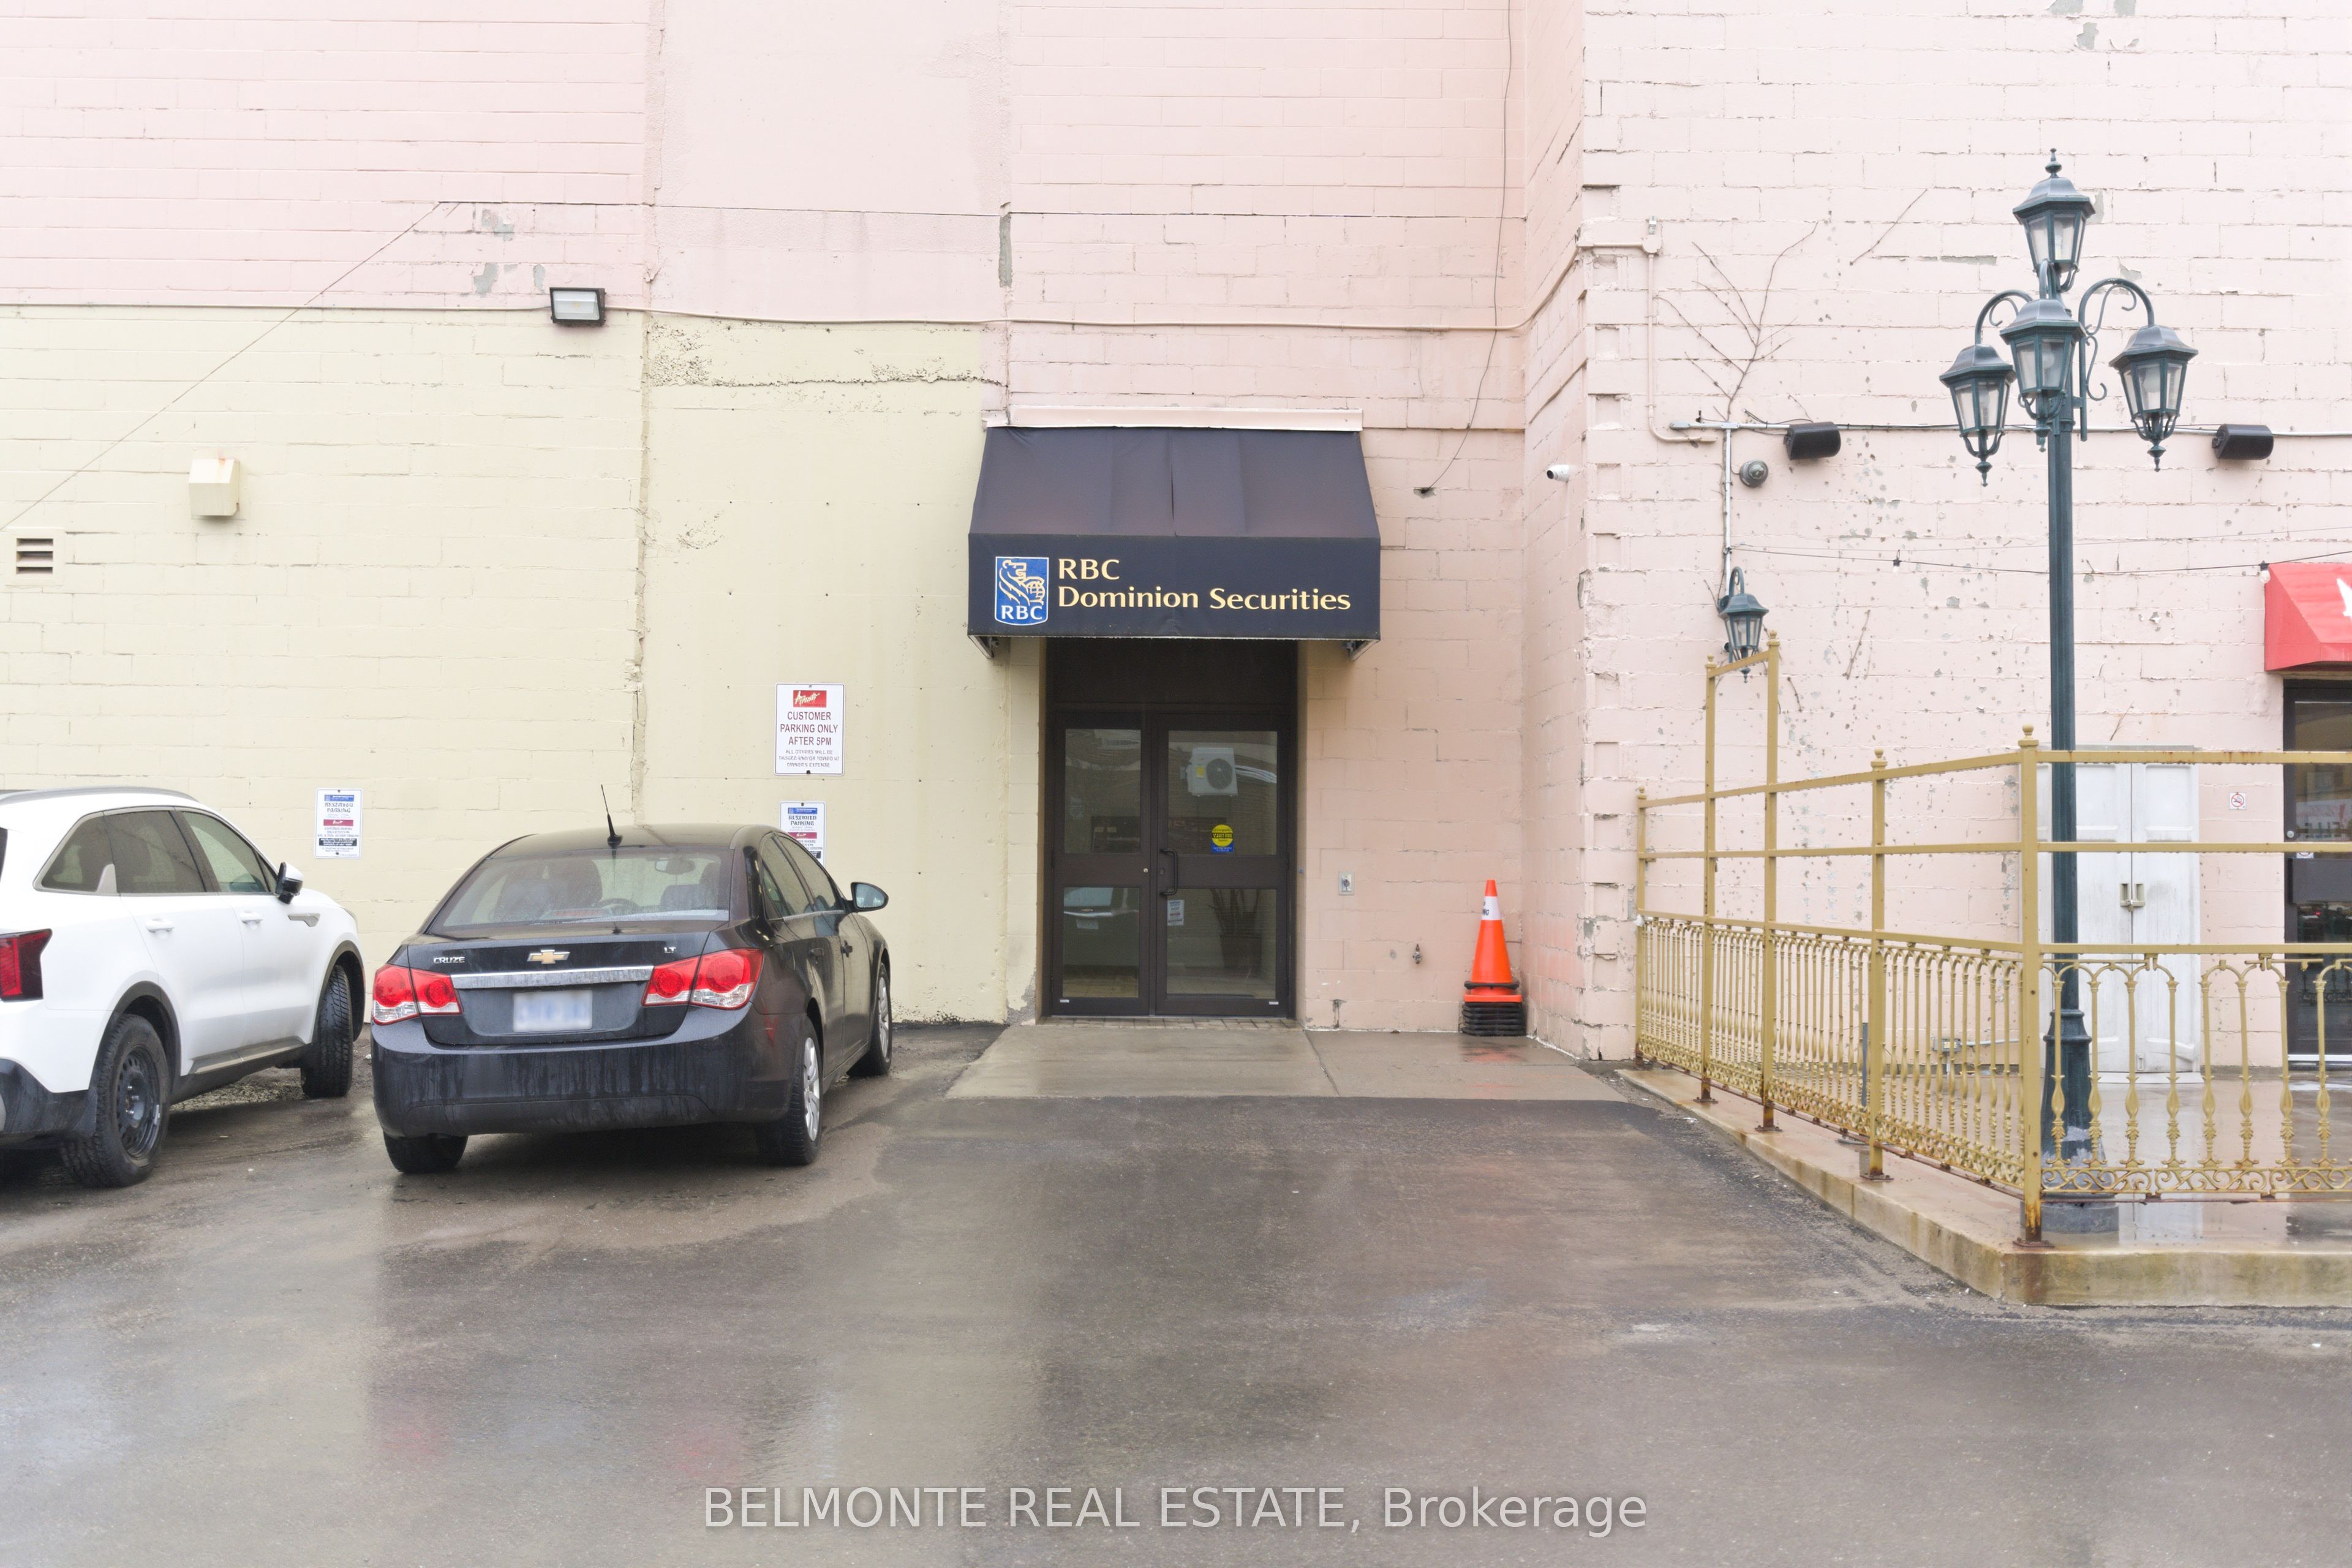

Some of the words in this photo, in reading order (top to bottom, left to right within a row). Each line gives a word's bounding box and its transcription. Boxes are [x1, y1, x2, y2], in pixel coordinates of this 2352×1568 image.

[1058, 558, 1120, 580] RBC
[1058, 586, 1199, 608] Dominion
[1210, 587, 1351, 610] Securities
[1001, 605, 1042, 620] RBC
[787, 711, 832, 720] CUSTOMER
[780, 723, 815, 733] PARKING
[817, 724, 839, 733] ONLY
[788, 736, 814, 745] AFTER
[816, 737, 832, 746] 5PM
